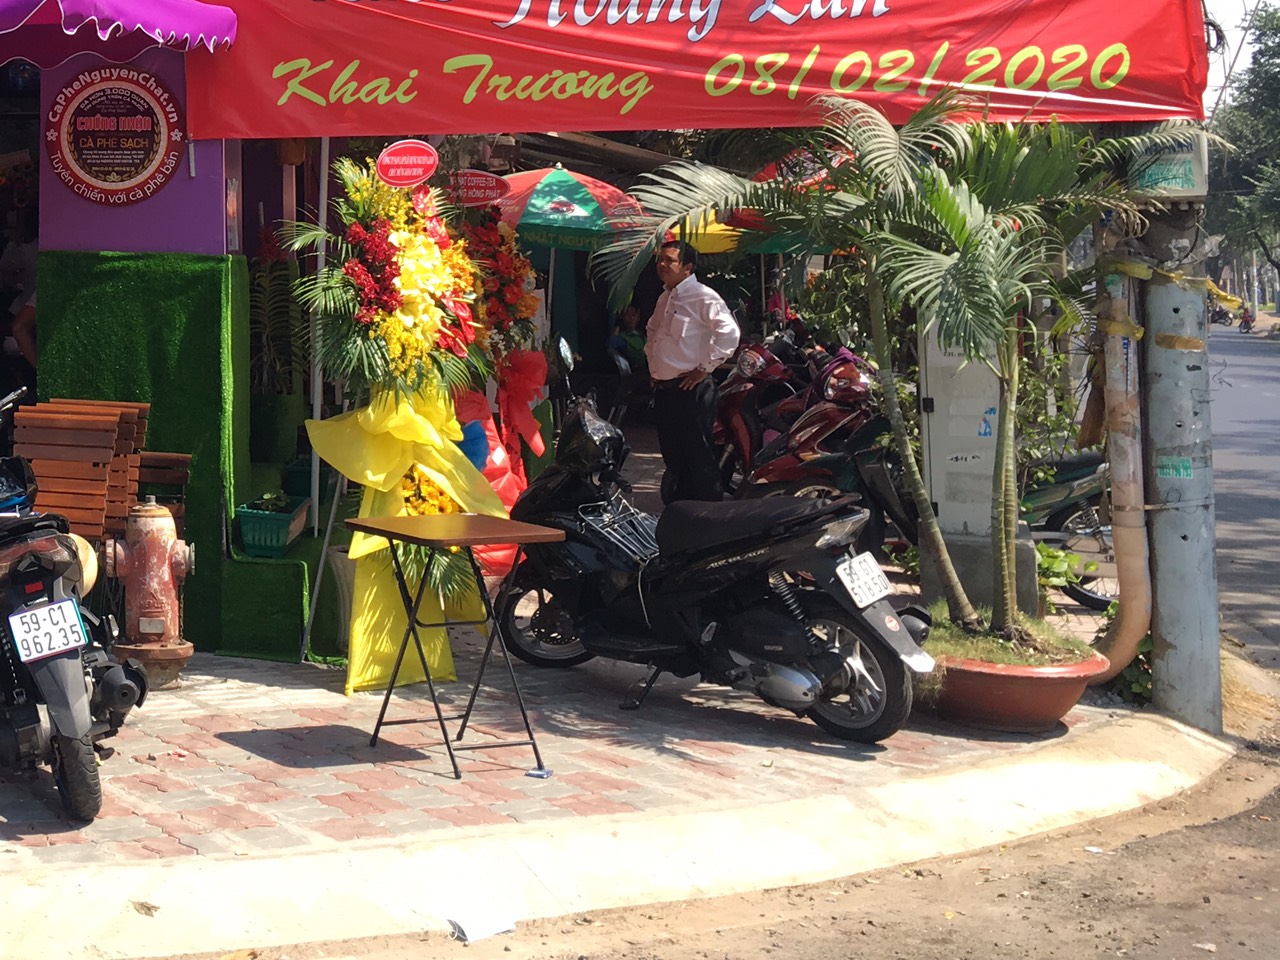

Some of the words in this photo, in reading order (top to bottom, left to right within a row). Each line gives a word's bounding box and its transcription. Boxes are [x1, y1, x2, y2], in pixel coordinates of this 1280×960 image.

[271, 57, 419, 107] Khai
[129, 188, 144, 200] cà
[144, 172, 166, 196] phê
[19, 604, 68, 635] 59-C1
[20, 623, 82, 658] 962.35
